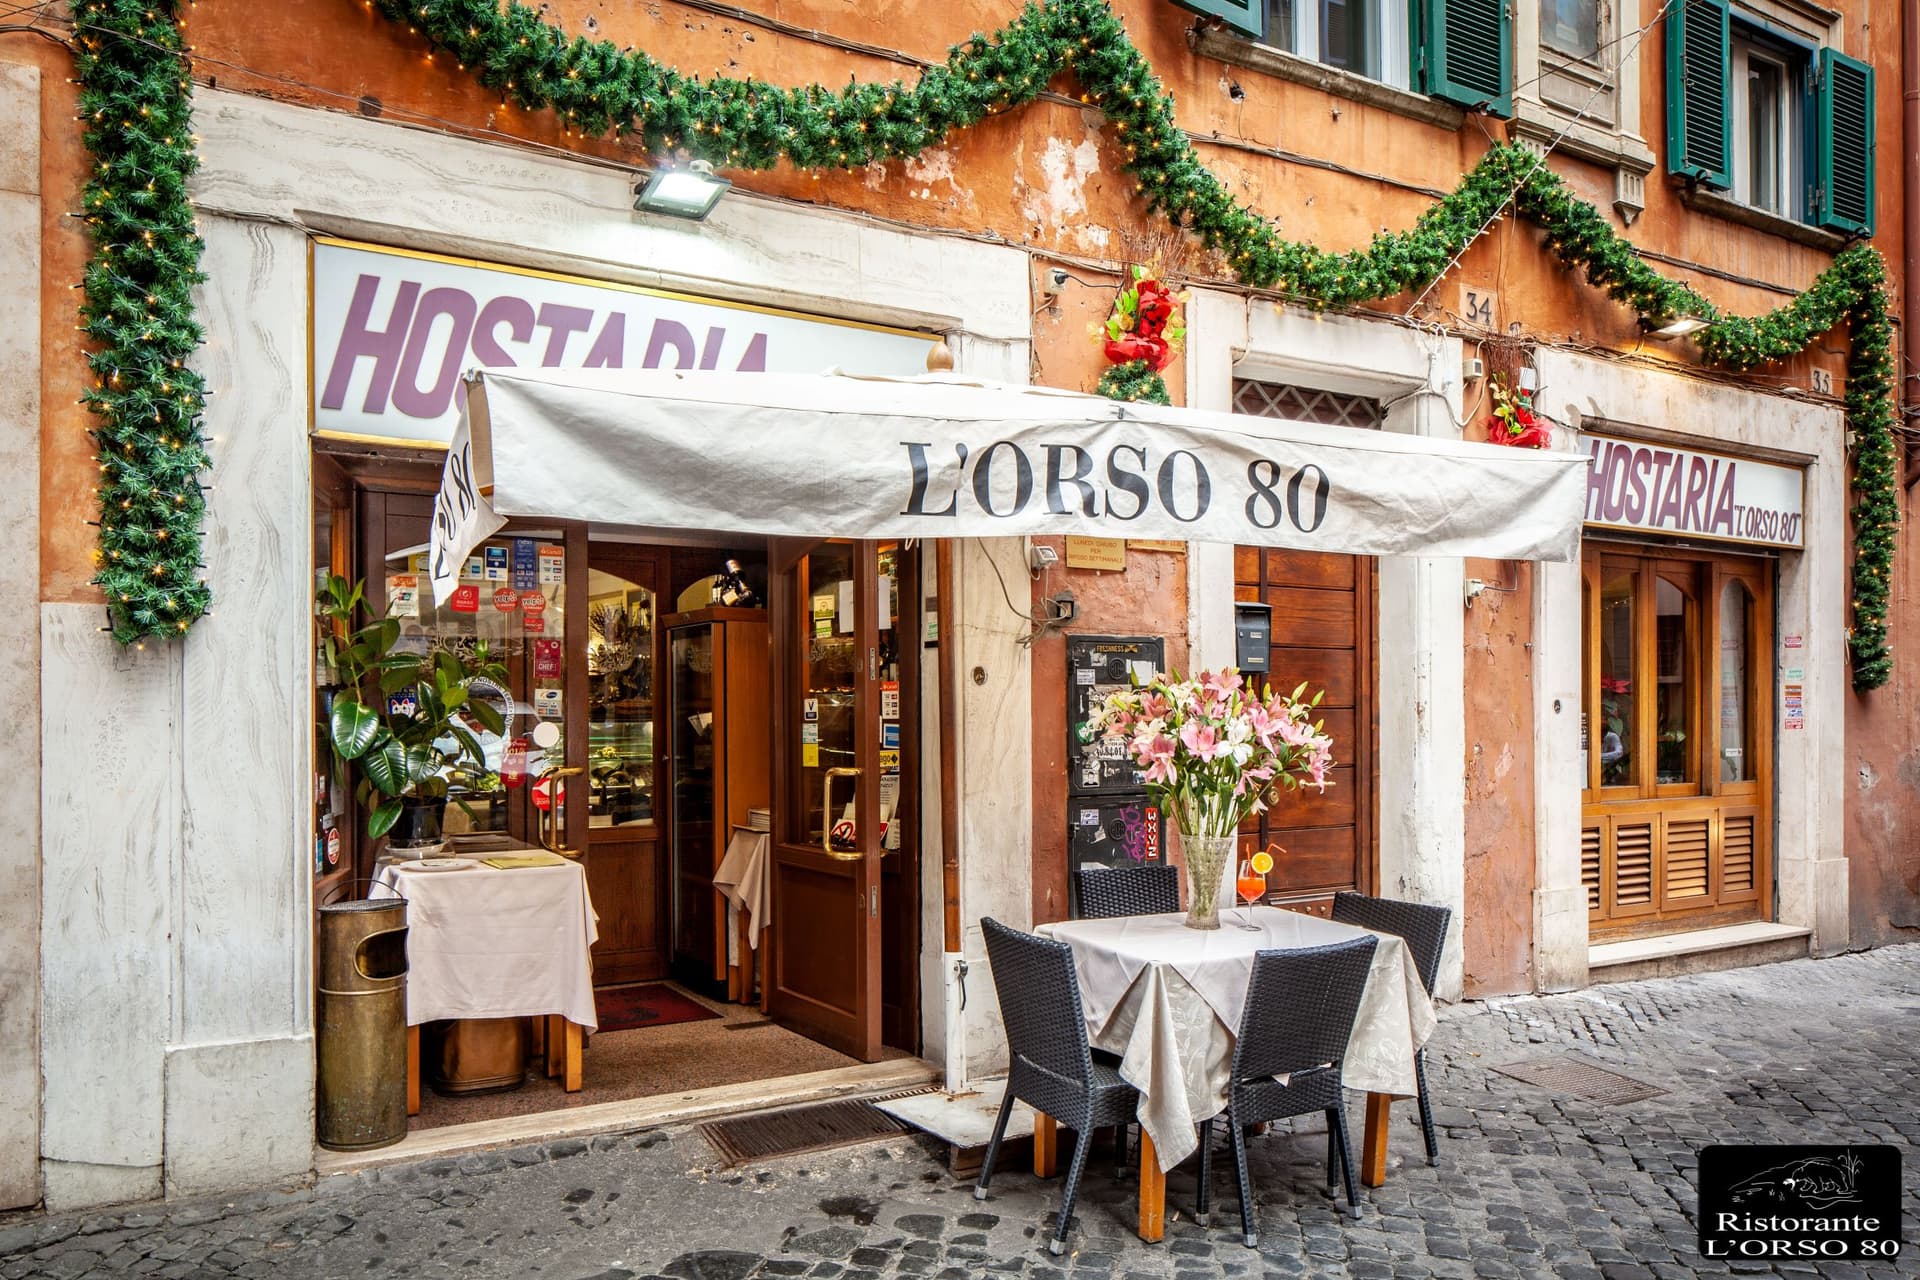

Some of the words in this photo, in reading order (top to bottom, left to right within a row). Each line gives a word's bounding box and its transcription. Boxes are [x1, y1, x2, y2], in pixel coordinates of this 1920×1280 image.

[1466, 292, 1491, 323] 34
[321, 274, 767, 418] HOST
[1813, 370, 1829, 392] 35
[900, 441, 1211, 522] L'ORSO
[1245, 459, 1329, 533] 80
[1584, 440, 1736, 535] HOSTARIA
[1096, 645, 1124, 653] FRESHNESS
[1147, 811, 1157, 857] WXYZ
